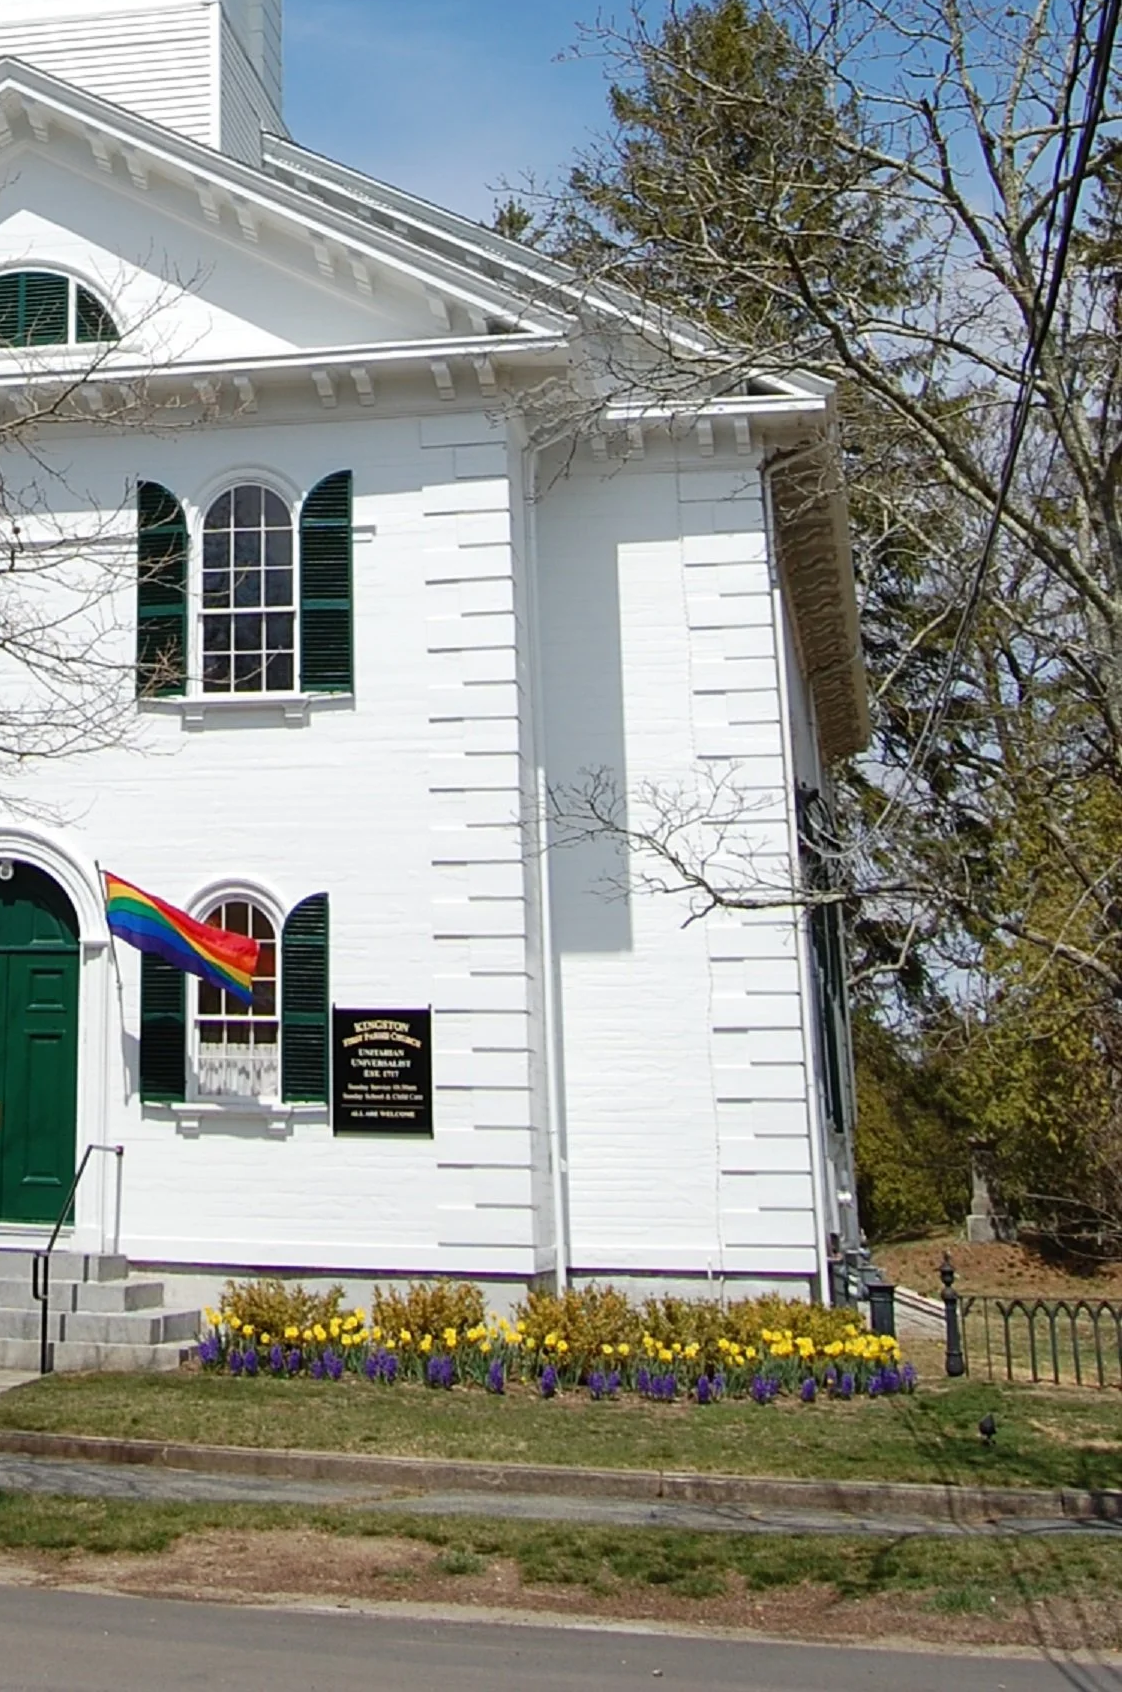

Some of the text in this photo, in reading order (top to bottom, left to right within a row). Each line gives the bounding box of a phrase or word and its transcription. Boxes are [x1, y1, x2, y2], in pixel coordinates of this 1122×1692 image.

[353, 1019, 410, 1033] KINGSTON
[358, 1048, 405, 1057] UNITARIAN
[350, 1058, 411, 1068] UNIVERSALIST
